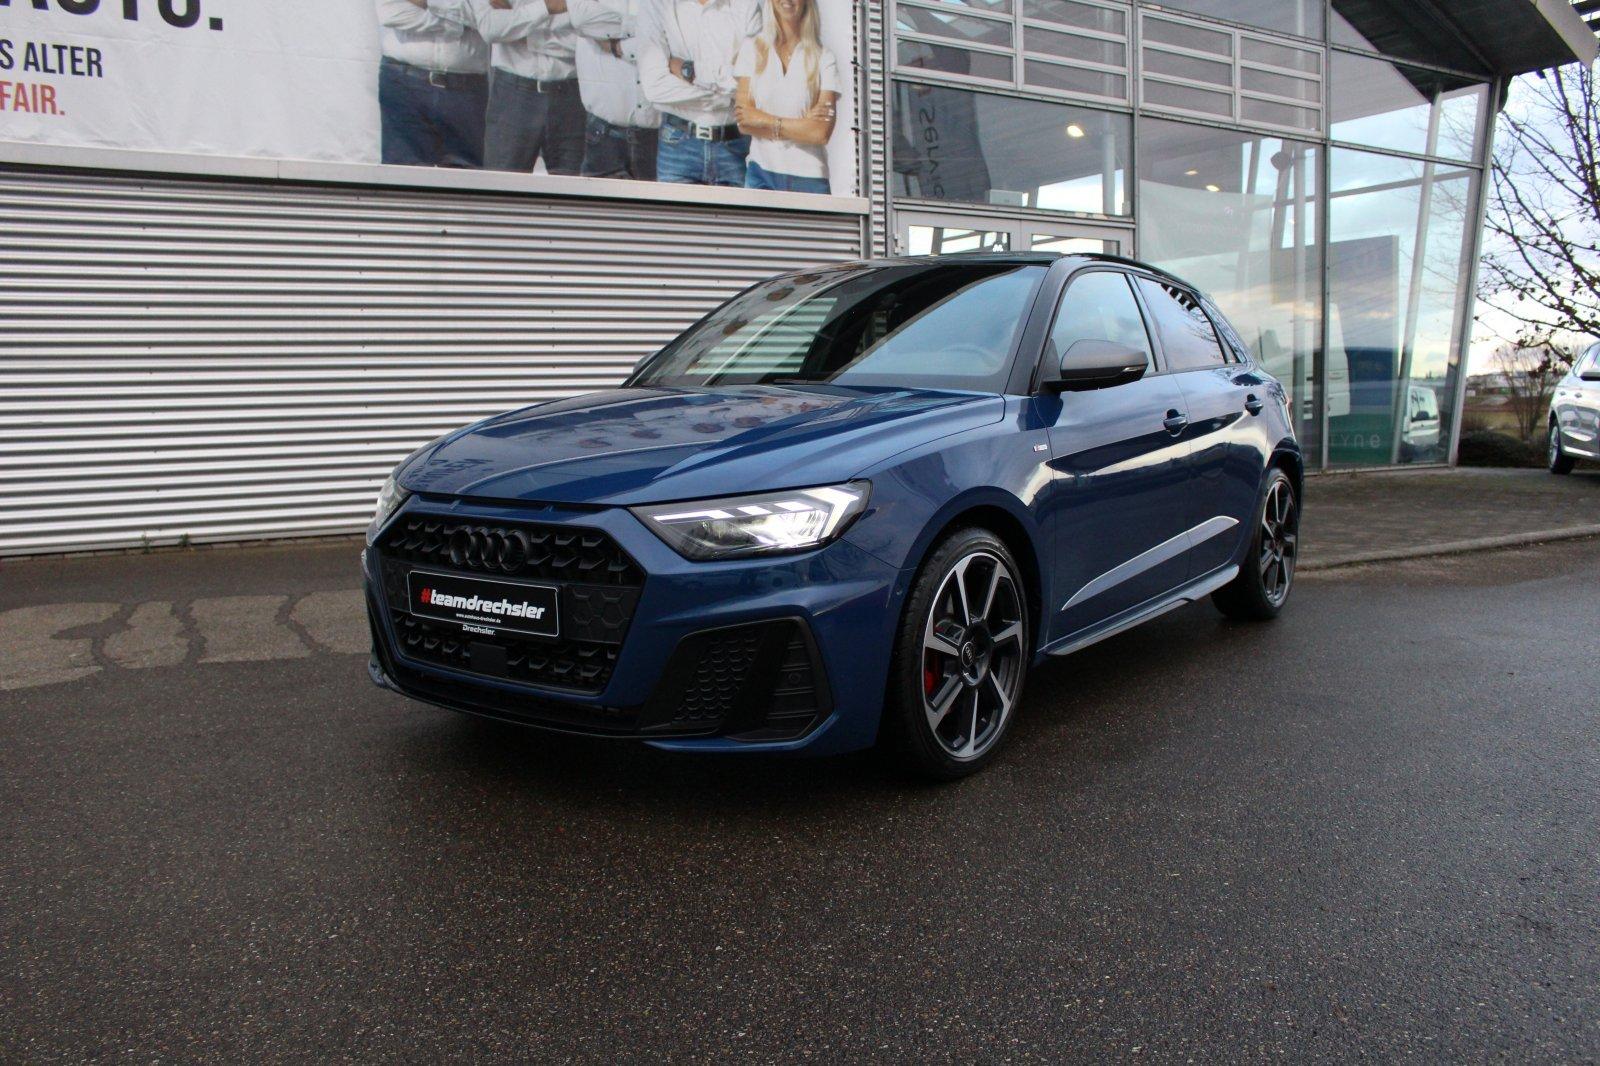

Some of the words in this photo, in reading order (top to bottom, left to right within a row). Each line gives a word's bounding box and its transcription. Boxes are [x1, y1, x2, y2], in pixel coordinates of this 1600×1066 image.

[23, 41, 103, 78] ALTER
[0, 81, 66, 116] FAIR.
[420, 587, 546, 620] #teamdrechsler
